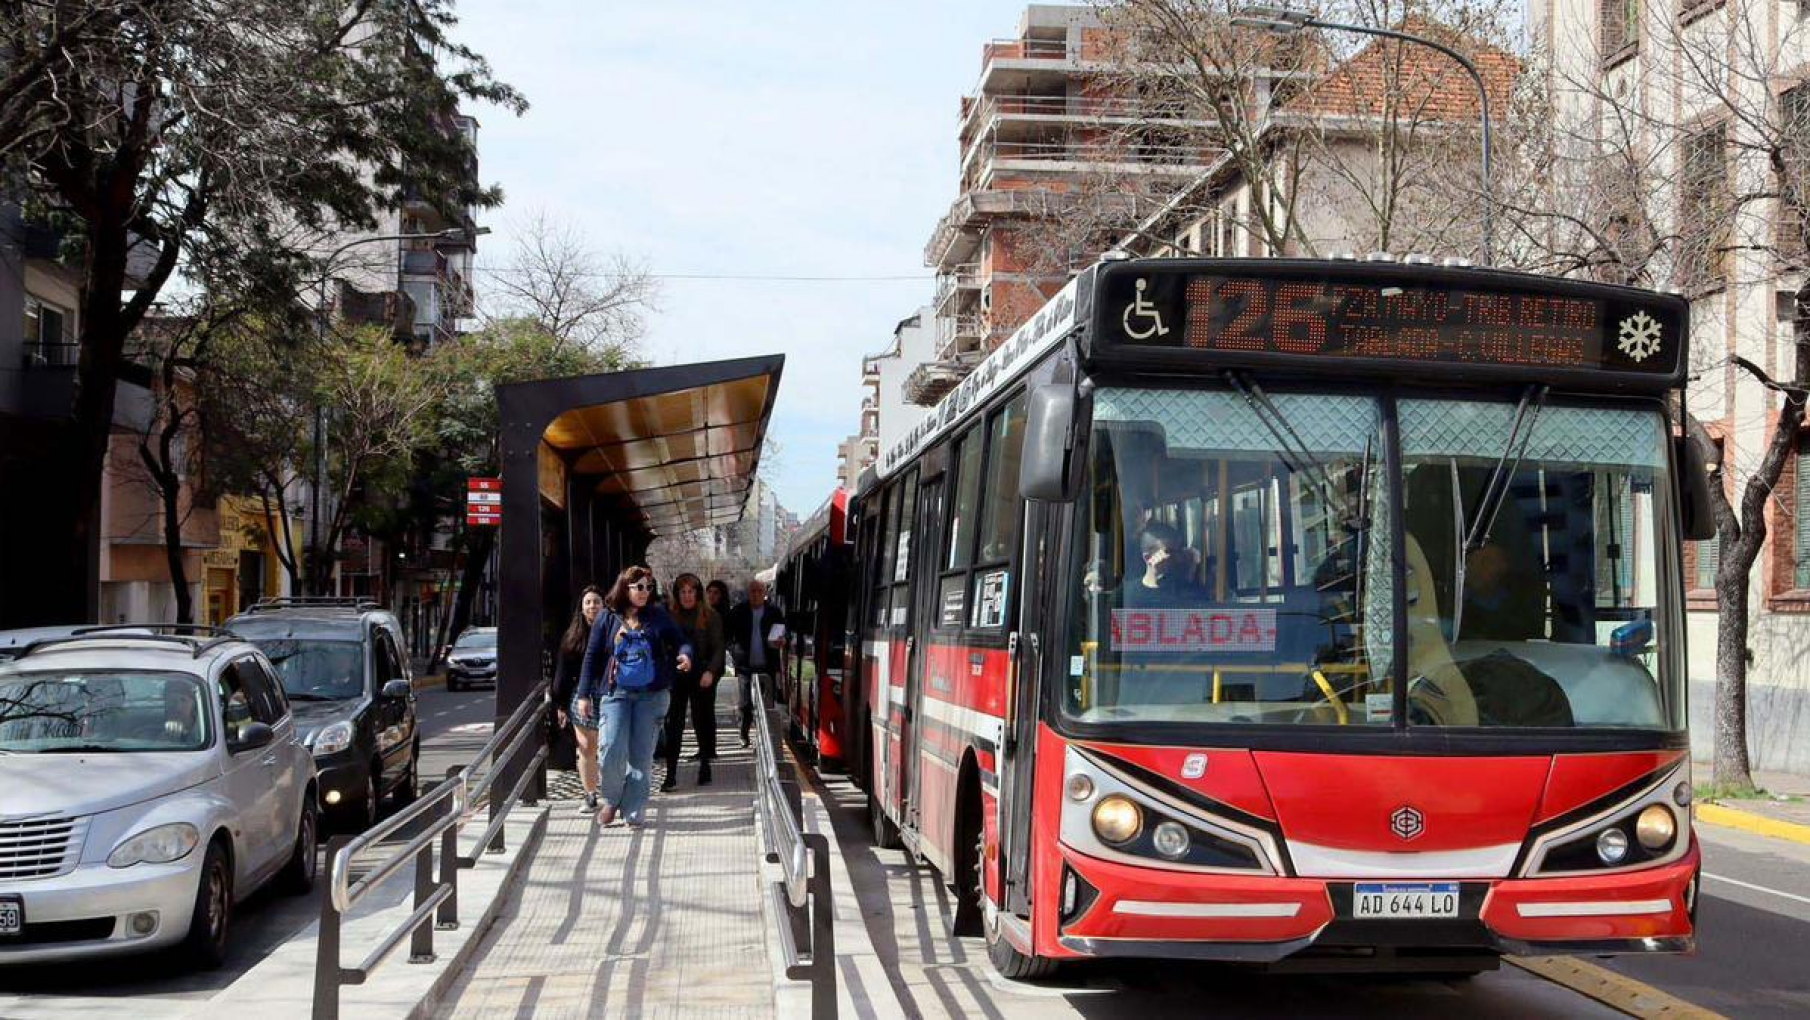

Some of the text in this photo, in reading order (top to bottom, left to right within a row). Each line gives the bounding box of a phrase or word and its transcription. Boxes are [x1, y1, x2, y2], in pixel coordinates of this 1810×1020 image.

[1185, 277, 1328, 356] 126
[1360, 894, 1454, 914] AD 644 LO
